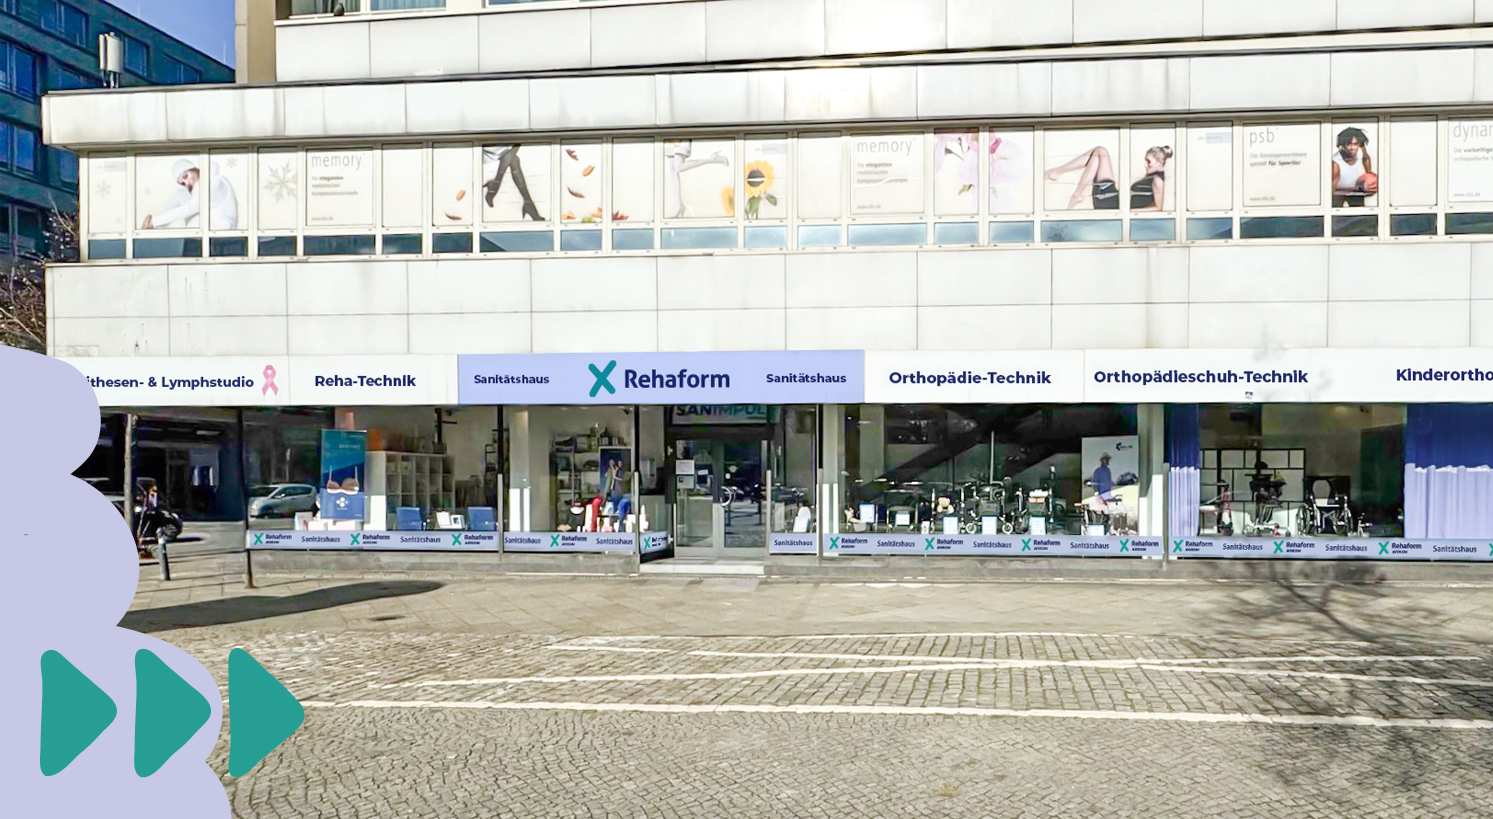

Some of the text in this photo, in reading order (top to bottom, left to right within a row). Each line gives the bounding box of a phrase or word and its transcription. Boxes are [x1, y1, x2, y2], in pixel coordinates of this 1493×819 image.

[1249, 127, 1275, 148] psb
[857, 141, 912, 156] memory
[311, 154, 362, 170] memory
[148, 376, 157, 388] &
[161, 375, 254, 390] Lymphstudio
[314, 374, 417, 387] Reha-Technik
[474, 368, 847, 389] Sanitätshaus Rehaform Sanitätshaus
[888, 370, 1052, 387] Orthopädie-Technik
[1093, 369, 1309, 386] Orthopädieschuh-Technik
[301, 535, 341, 543] Sanitätshaus
[504, 536, 542, 544] Sanitätshaus
[596, 537, 633, 545] Sanitätshaus
[1070, 541, 1110, 549] Sanitätshaus
[1222, 542, 1263, 551] Sanitätshaus
[1325, 543, 1368, 552] Sanitätshaus
[1433, 544, 1477, 553] Sanitätshaus
